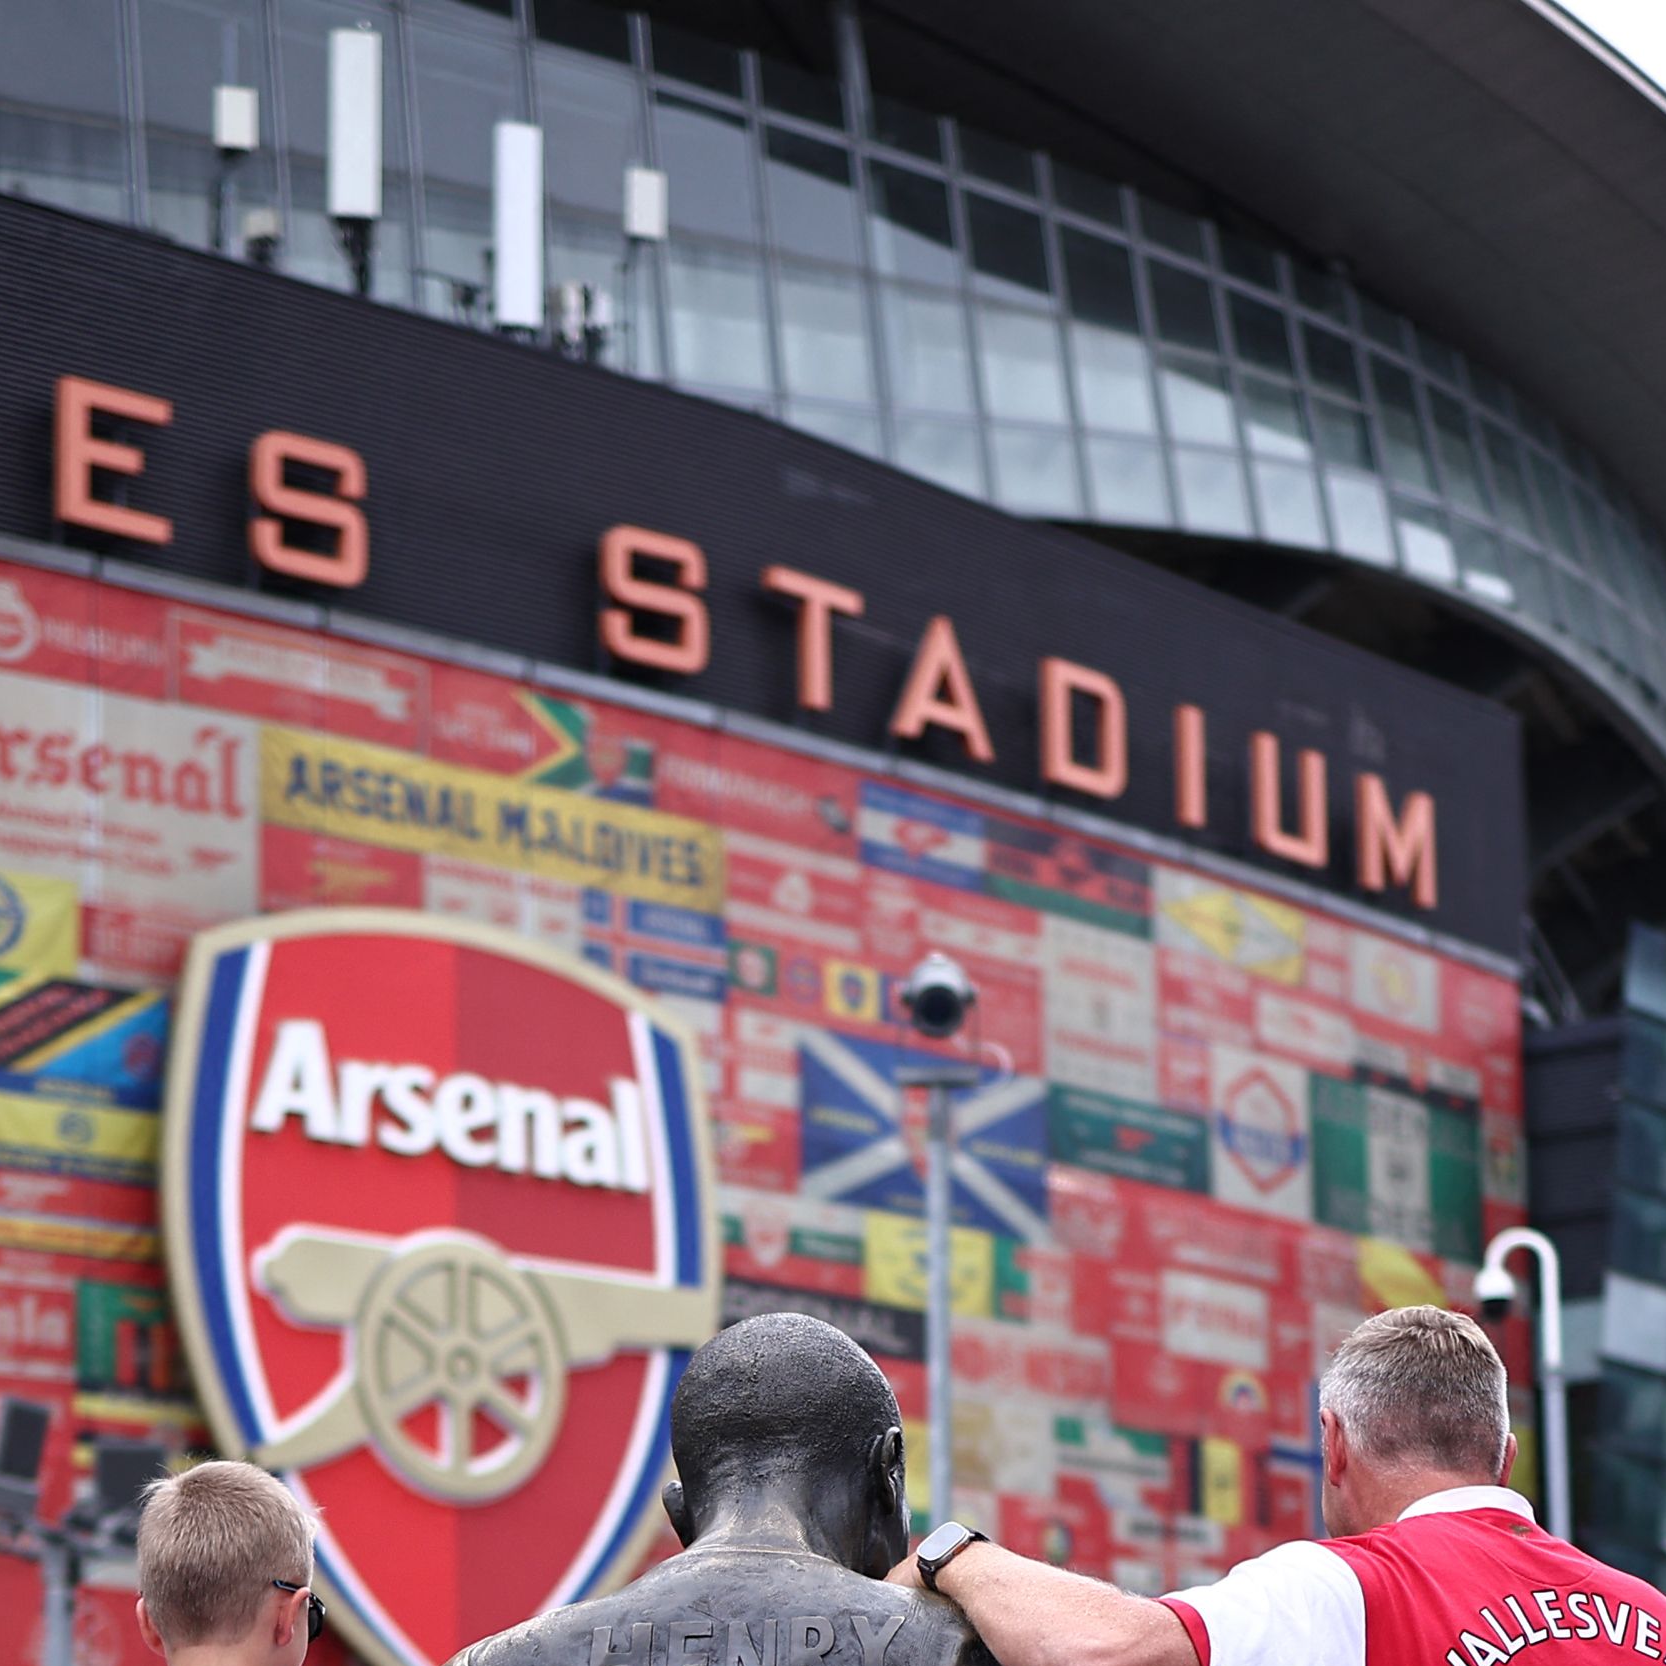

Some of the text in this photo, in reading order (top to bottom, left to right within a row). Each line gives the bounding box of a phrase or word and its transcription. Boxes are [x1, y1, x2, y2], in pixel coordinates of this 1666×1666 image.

[597, 526, 1439, 908] STADIUM
[282, 751, 705, 889] ARSENAL MALDIVES
[250, 1017, 650, 1193] Arsenal
